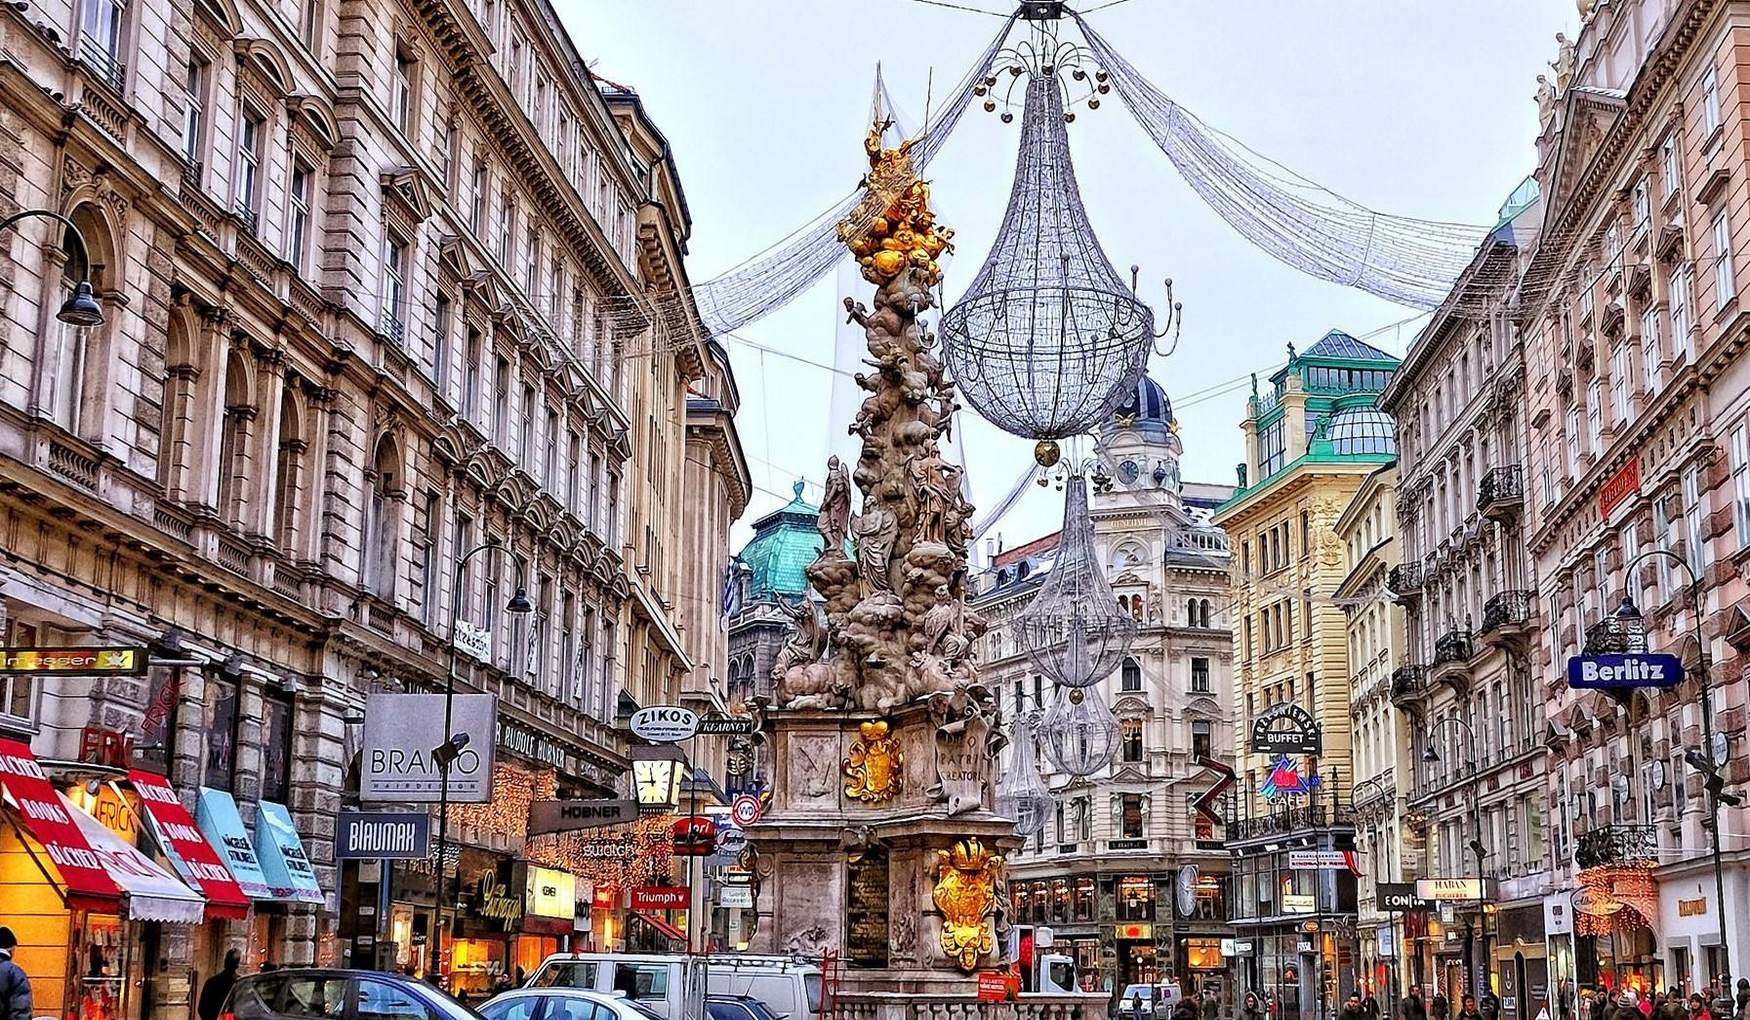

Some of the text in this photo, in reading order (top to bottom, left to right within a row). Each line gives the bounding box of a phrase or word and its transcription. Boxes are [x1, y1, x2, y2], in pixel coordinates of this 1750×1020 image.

[1582, 660, 1664, 682] Berlitz
[639, 709, 692, 726] ZIKOS
[1267, 733, 1304, 744] BUFFET
[20, 798, 70, 825] BOOKS
[636, 891, 677, 904] Triumph
